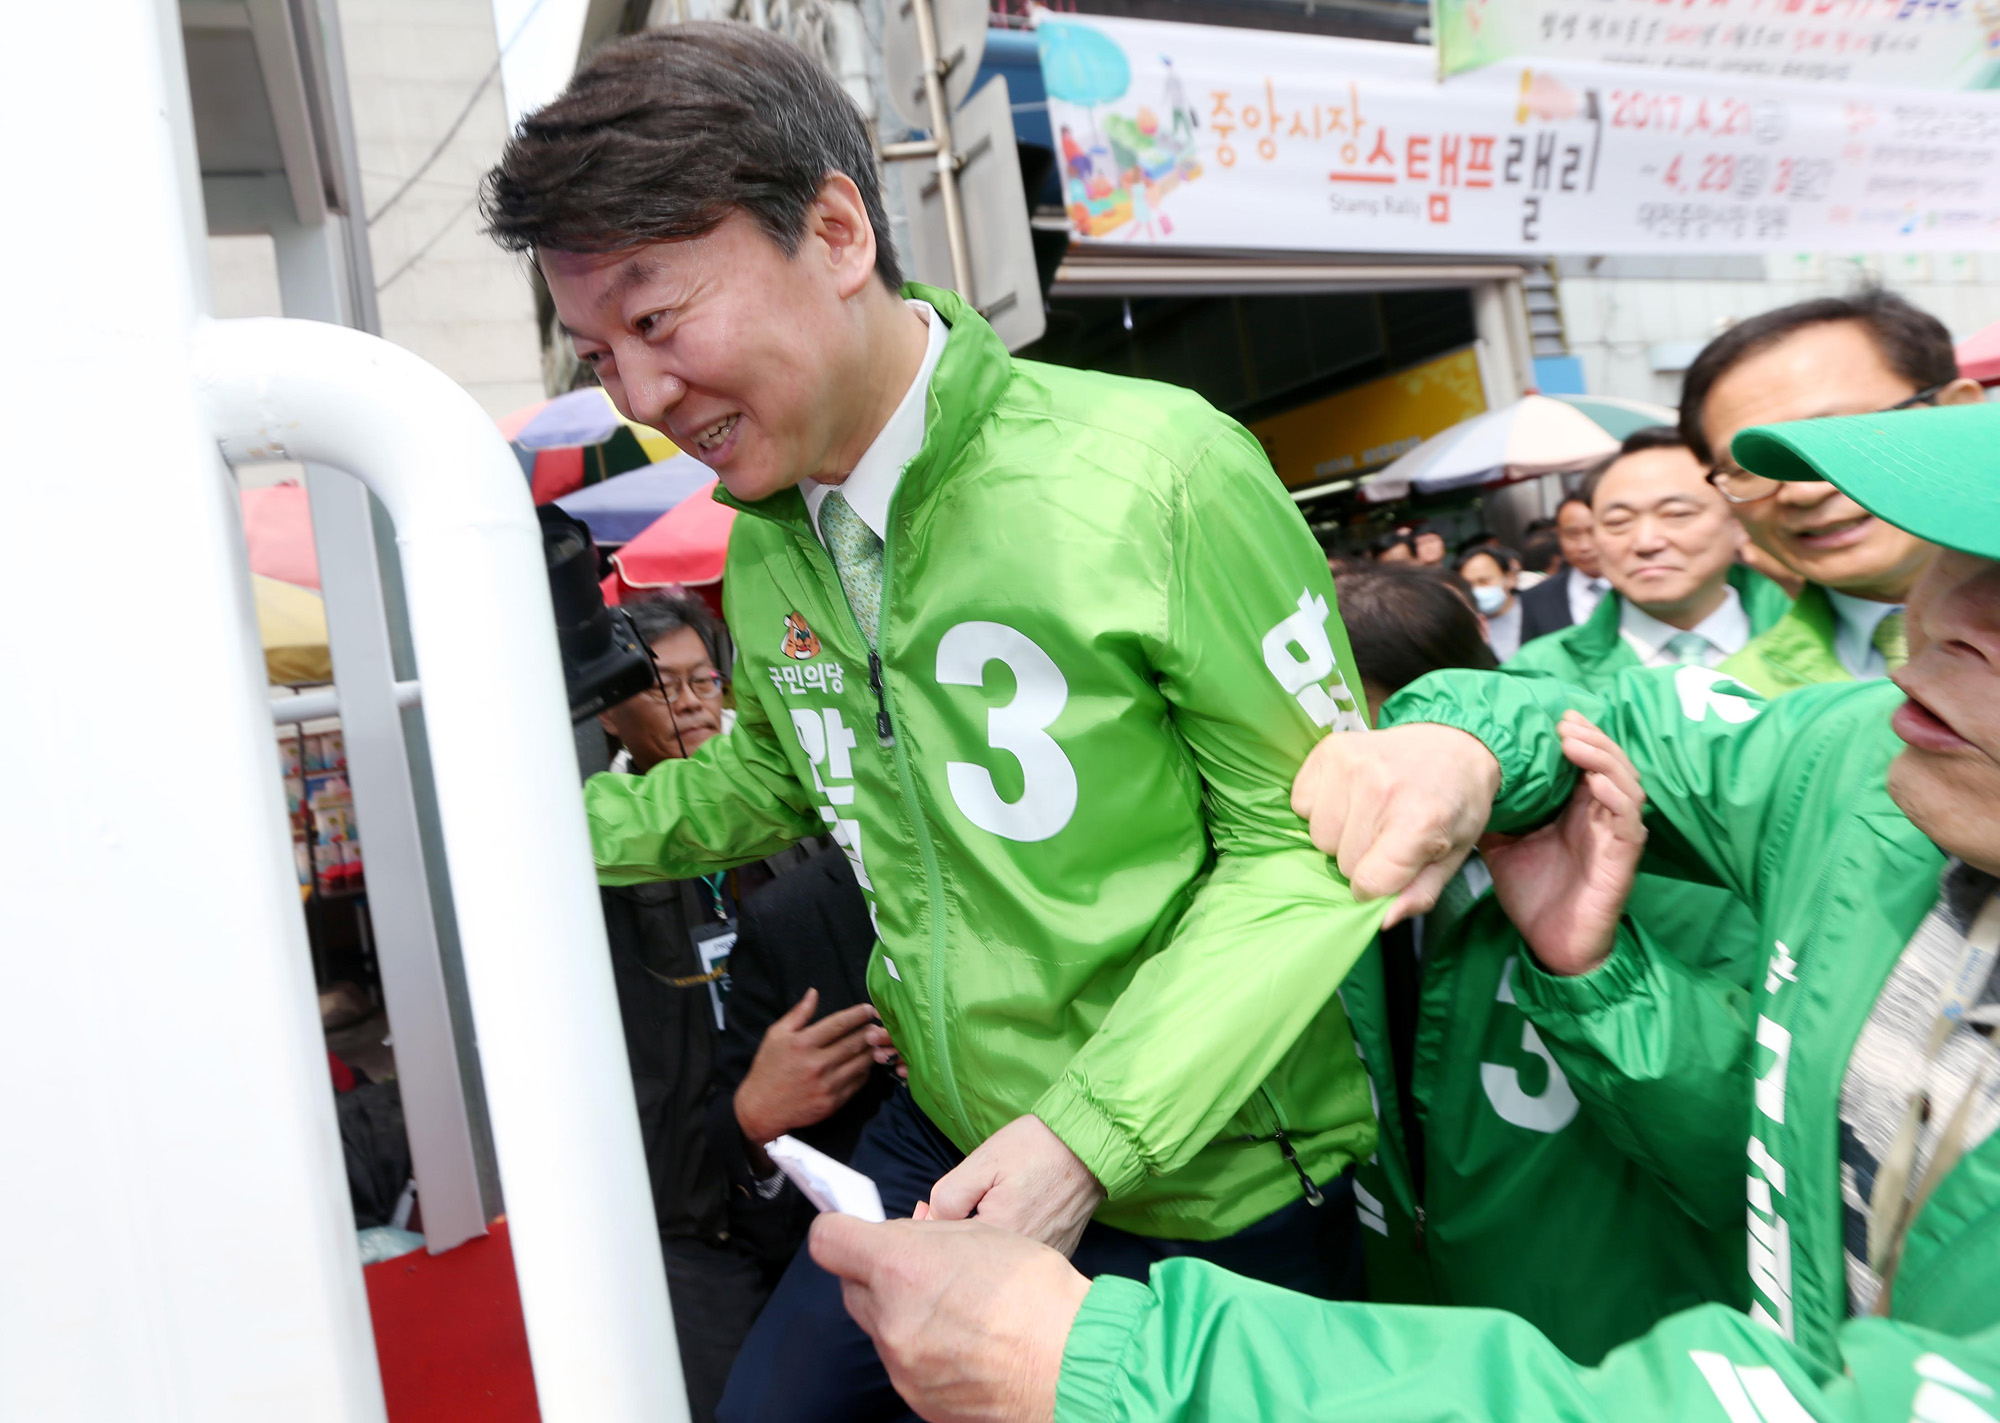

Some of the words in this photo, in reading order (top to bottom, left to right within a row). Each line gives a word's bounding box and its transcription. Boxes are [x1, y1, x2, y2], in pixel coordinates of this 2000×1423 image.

[1210, 77, 1366, 167] 중앙시장
[1329, 128, 1601, 242] 스탬프랠리
[1330, 192, 1378, 217] Stamp
[1385, 194, 1421, 219] Rally
[768, 662, 844, 697] 국민의당
[936, 621, 1078, 842] 3
